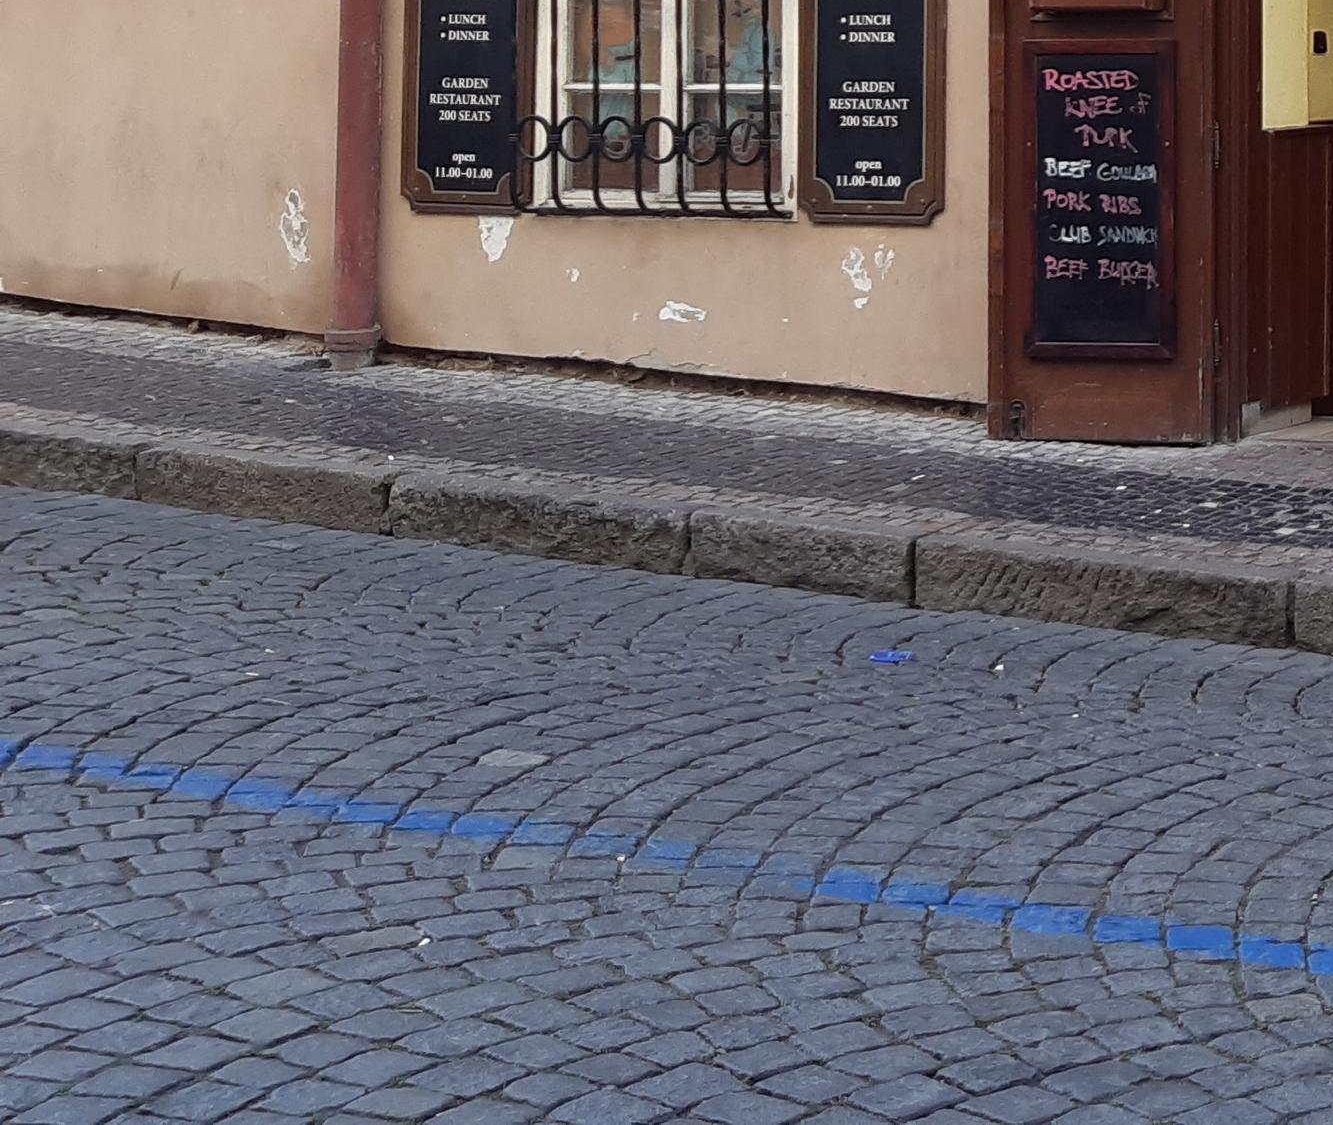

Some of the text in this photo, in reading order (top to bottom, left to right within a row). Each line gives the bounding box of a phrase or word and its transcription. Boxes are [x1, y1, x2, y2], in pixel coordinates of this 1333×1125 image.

[448, 14, 486, 25] LUNCH
[849, 14, 891, 26] LUNCH
[448, 30, 490, 41] DINNER
[849, 31, 896, 43] DINNER
[441, 77, 489, 89] GARDEN
[1042, 69, 1139, 91] ROASTED
[842, 81, 896, 93] GARDEN
[429, 93, 502, 106] RESTAURANT
[829, 98, 910, 110] RESTAURANT
[1064, 96, 1123, 119] KNEE
[438, 110, 491, 122] 200 SEATS
[840, 115, 899, 128] 200 SEATS
[452, 153, 476, 165] open
[855, 160, 882, 172] open
[1044, 157, 1092, 179] BEEF
[1043, 188, 1142, 215] PORK RIBS
[1048, 224, 1092, 244] CLUB
[1044, 255, 1089, 280] BEEF
